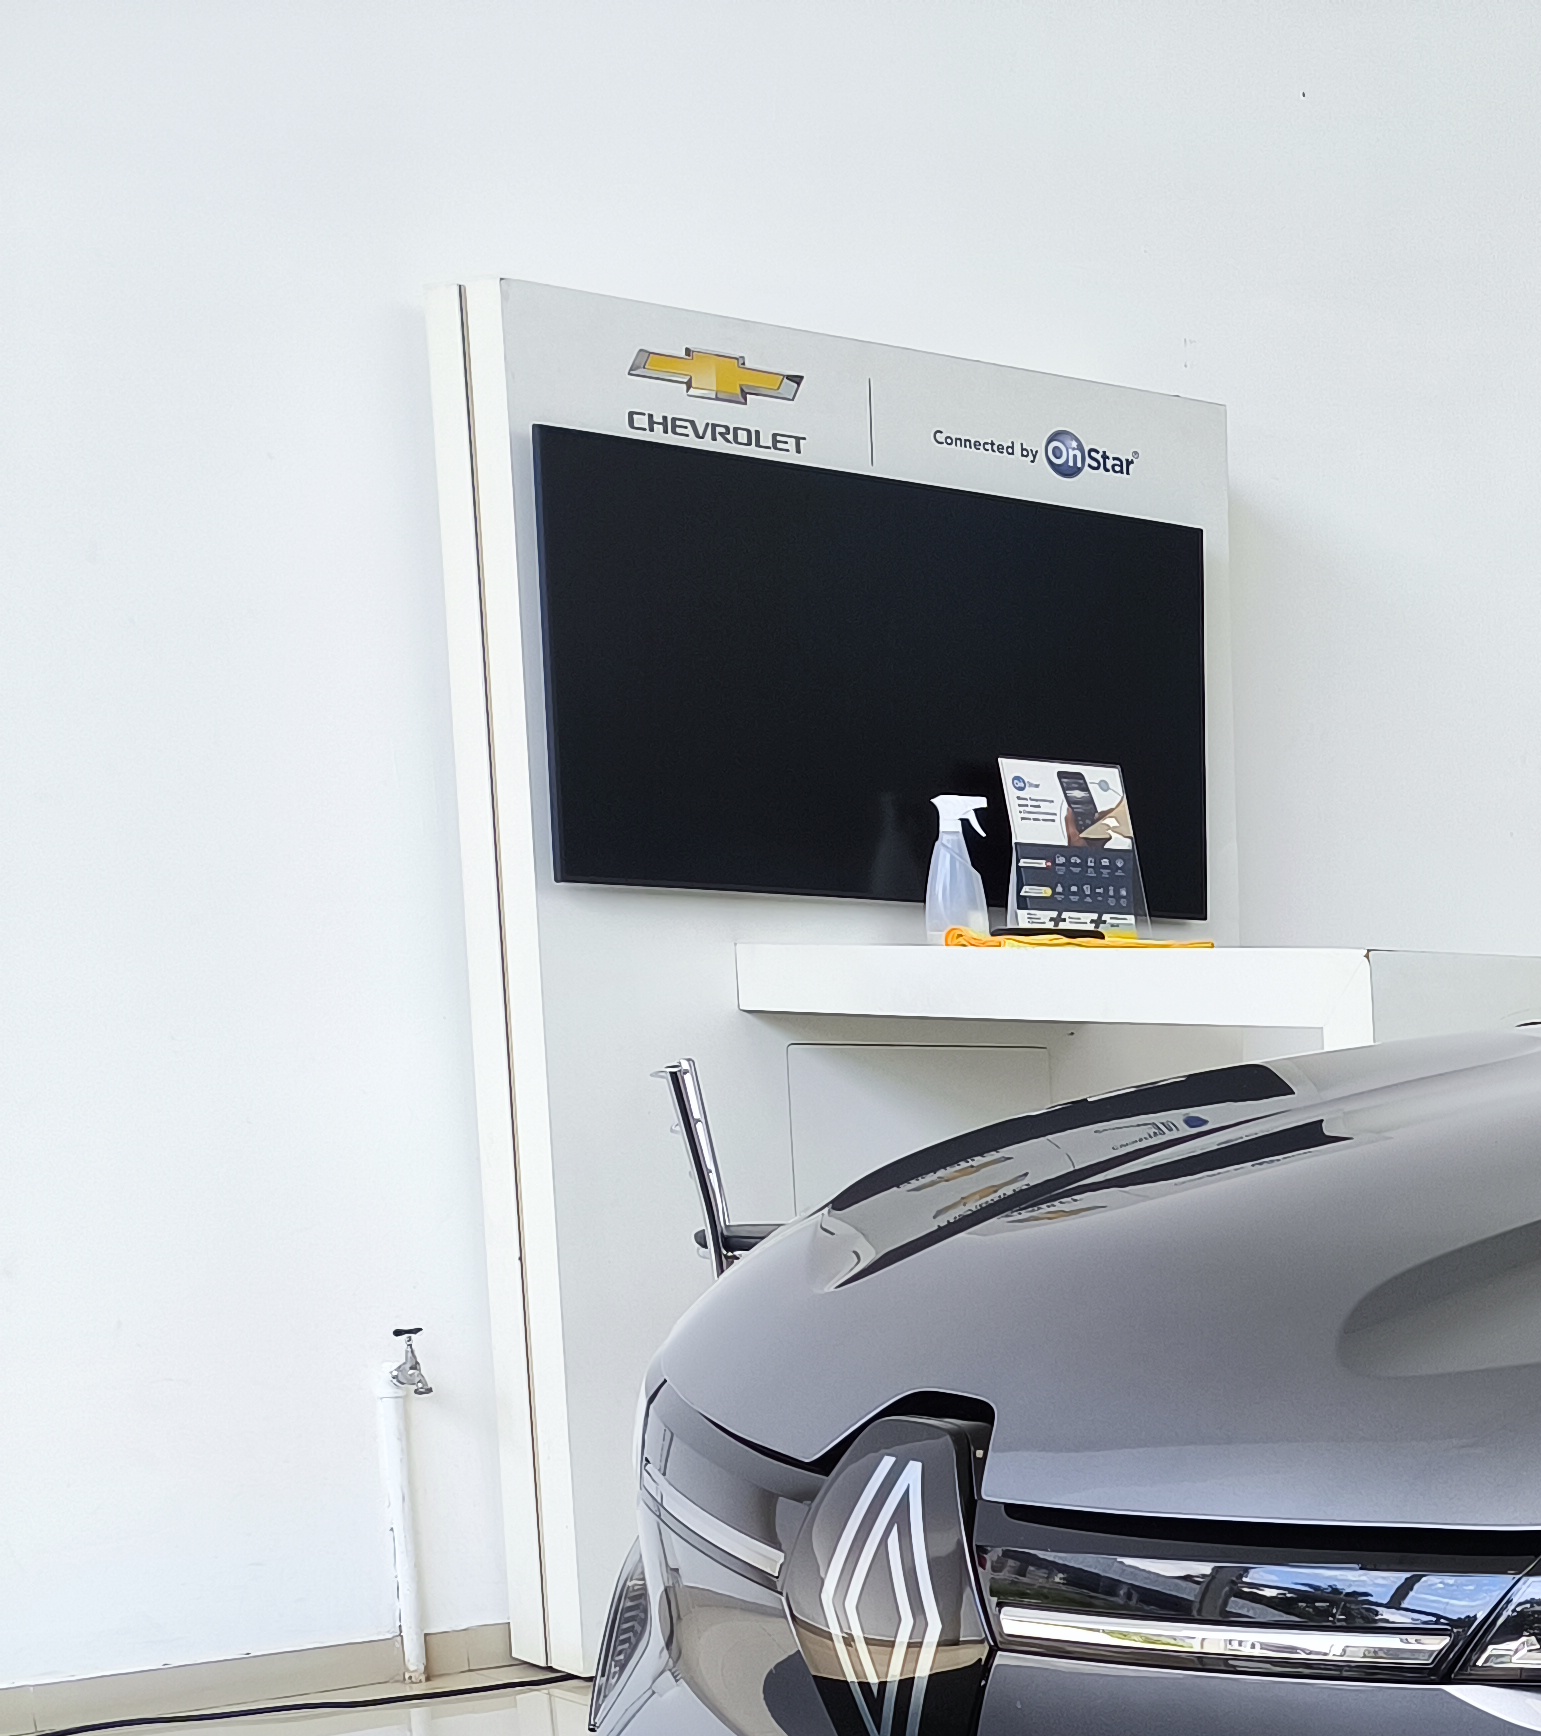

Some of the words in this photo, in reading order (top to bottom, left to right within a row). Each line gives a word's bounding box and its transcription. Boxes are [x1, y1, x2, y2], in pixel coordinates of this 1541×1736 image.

[628, 411, 806, 454] CHEVROLET
[933, 430, 1015, 456] Connected
[1020, 443, 1039, 463] by
